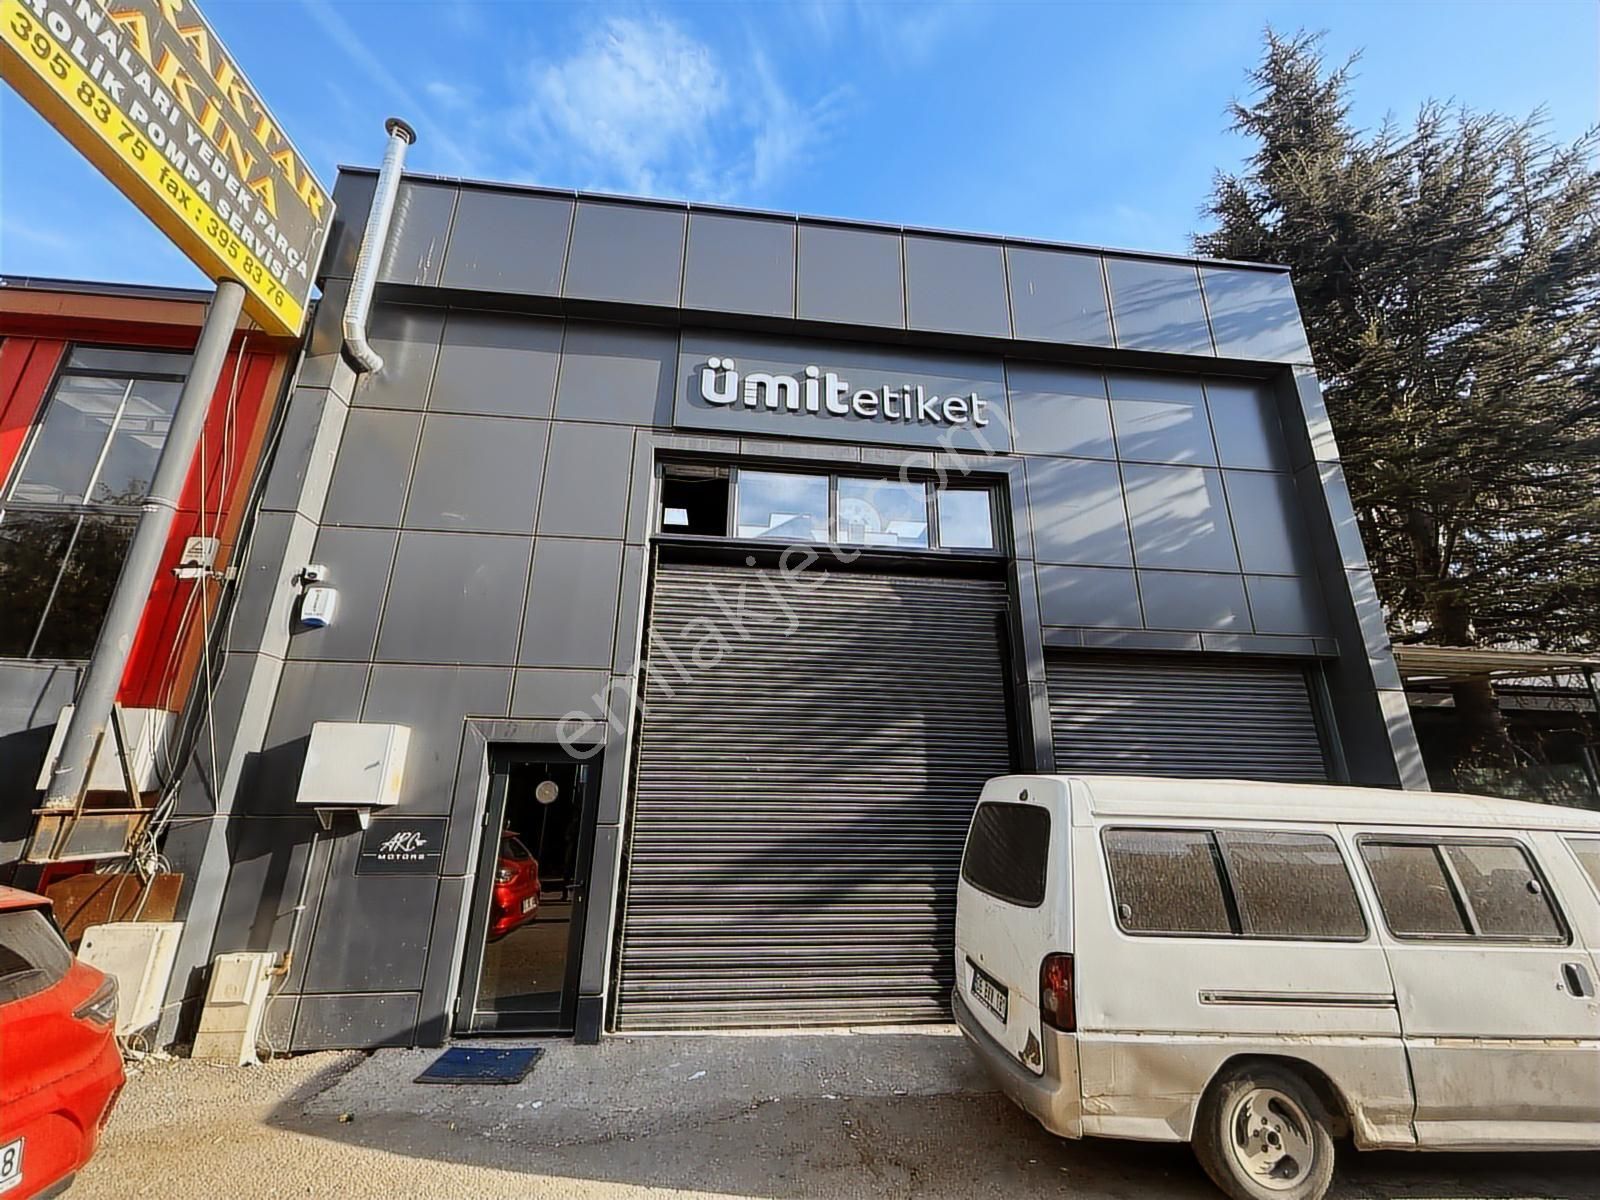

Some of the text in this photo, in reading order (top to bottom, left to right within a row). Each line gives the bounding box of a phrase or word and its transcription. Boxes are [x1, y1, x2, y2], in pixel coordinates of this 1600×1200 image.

[10, 12, 71, 80] 395
[76, 81, 111, 124] 83
[117, 123, 148, 162] 75
[158, 166, 192, 210] fax
[207, 218, 240, 259] 395
[243, 256, 263, 284] 83
[267, 280, 284, 307] 76
[64, 0, 308, 279] NALARI YEDEK PARÇA
[95, 0, 278, 219] AKİNA
[129, 100, 211, 201] POMPA
[216, 198, 290, 285] SERVİSİ
